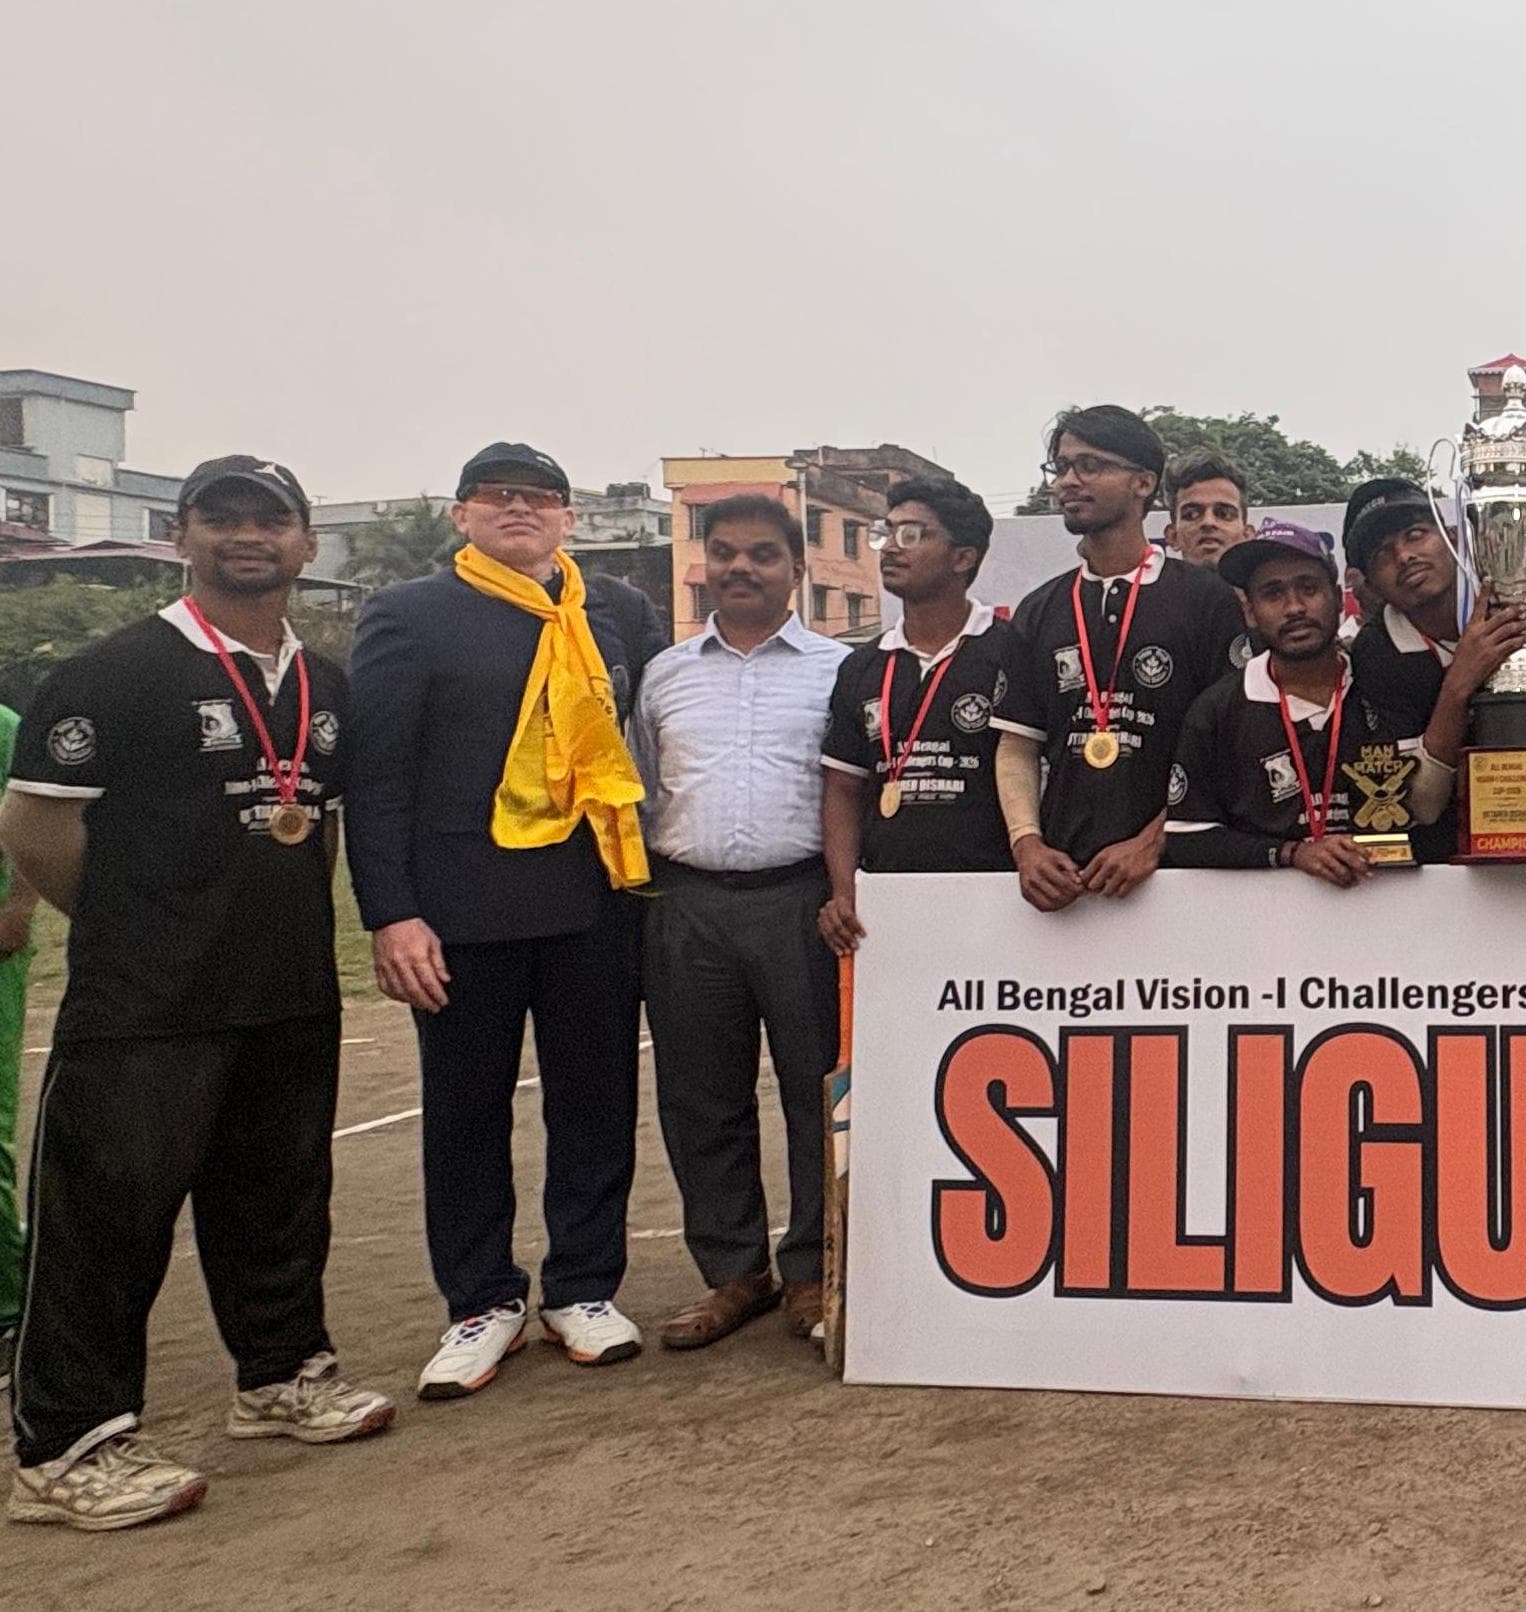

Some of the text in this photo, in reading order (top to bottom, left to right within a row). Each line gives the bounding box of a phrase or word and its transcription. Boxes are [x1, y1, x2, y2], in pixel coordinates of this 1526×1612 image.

[1360, 744, 1394, 757] MAN
[937, 979, 984, 1011] All
[996, 978, 1125, 1017] Bengal
[1136, 977, 1250, 1010] Vision
